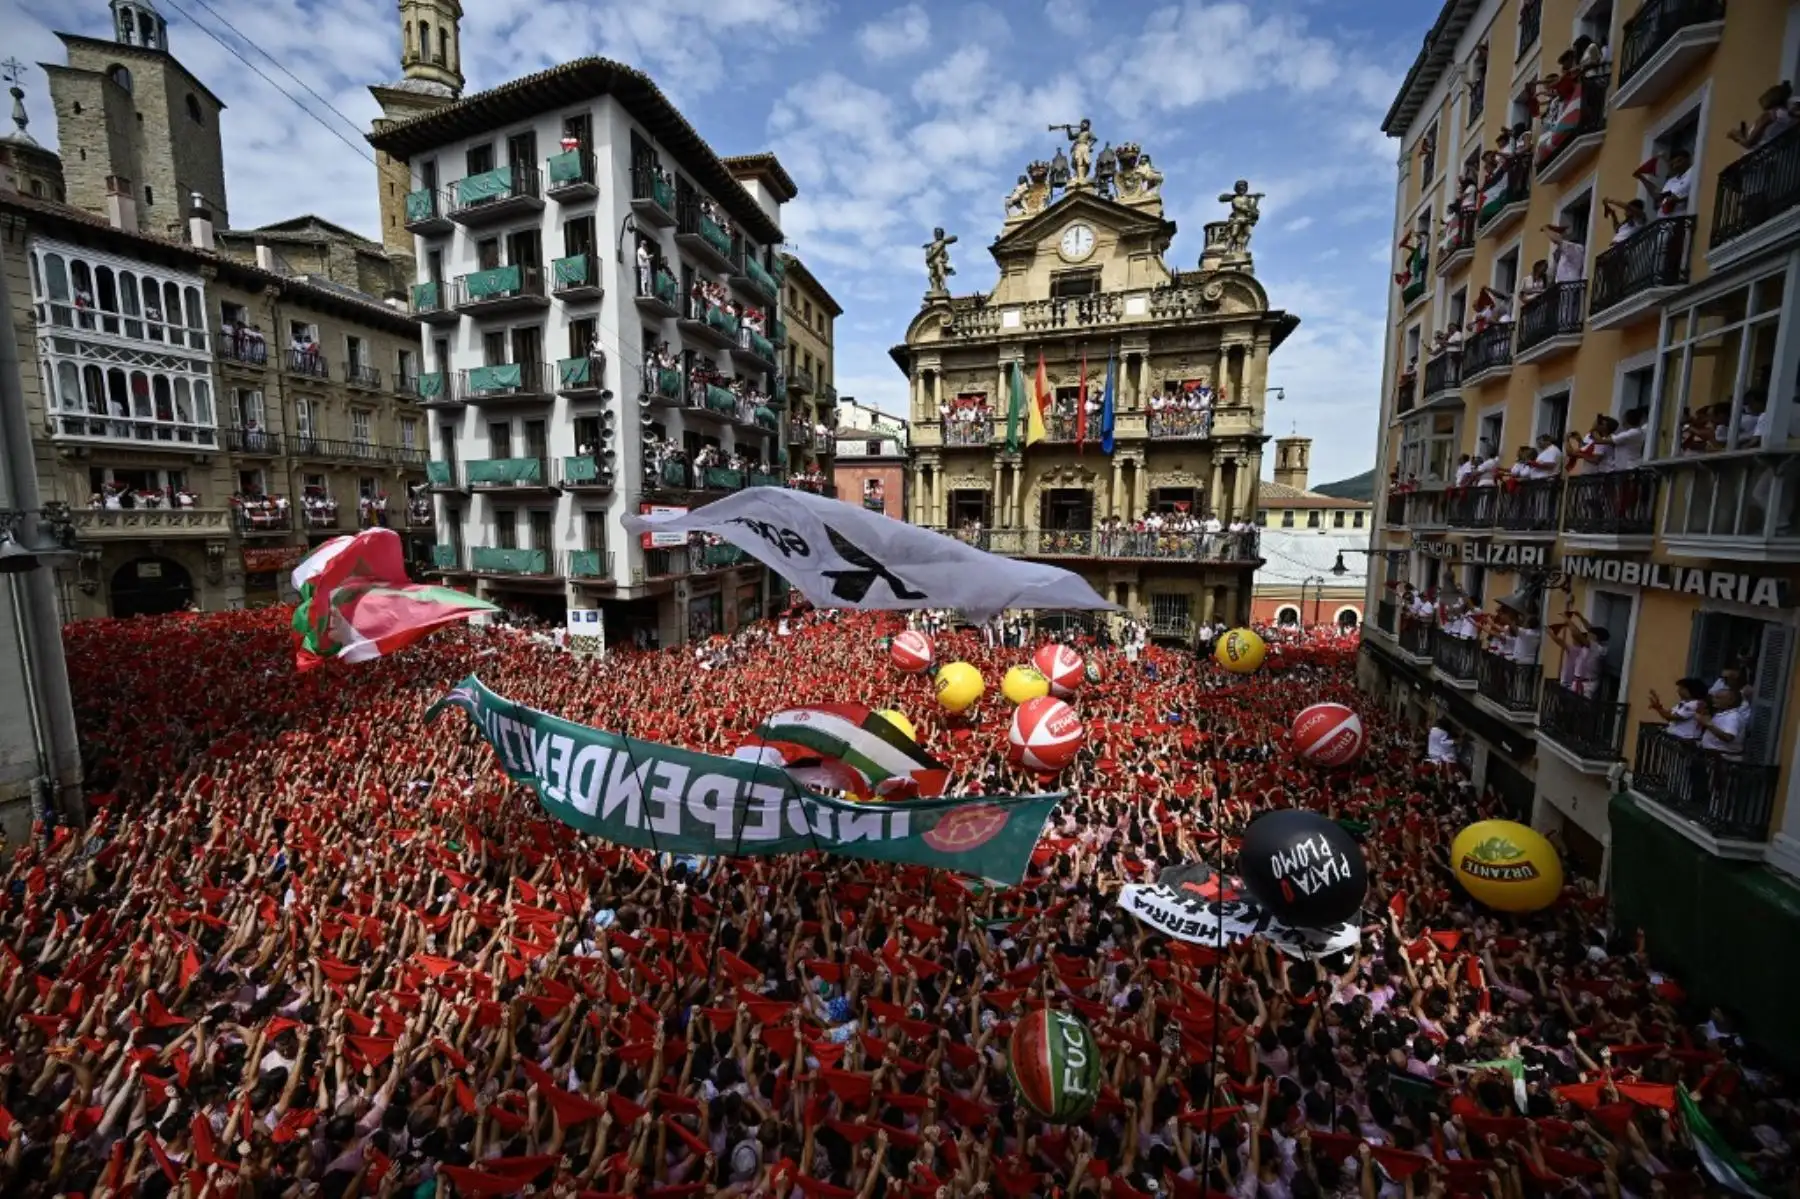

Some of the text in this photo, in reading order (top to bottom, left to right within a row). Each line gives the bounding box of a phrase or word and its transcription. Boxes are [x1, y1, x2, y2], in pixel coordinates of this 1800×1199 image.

[1462, 541, 1546, 566] ELIZARI
[1562, 554, 1781, 608] INMOBILIARIA
[1270, 833, 1332, 880] PLOMO
[1291, 851, 1351, 896] PLATA
[1462, 859, 1534, 881] URZANTE
[1132, 893, 1218, 942] HERRIA
